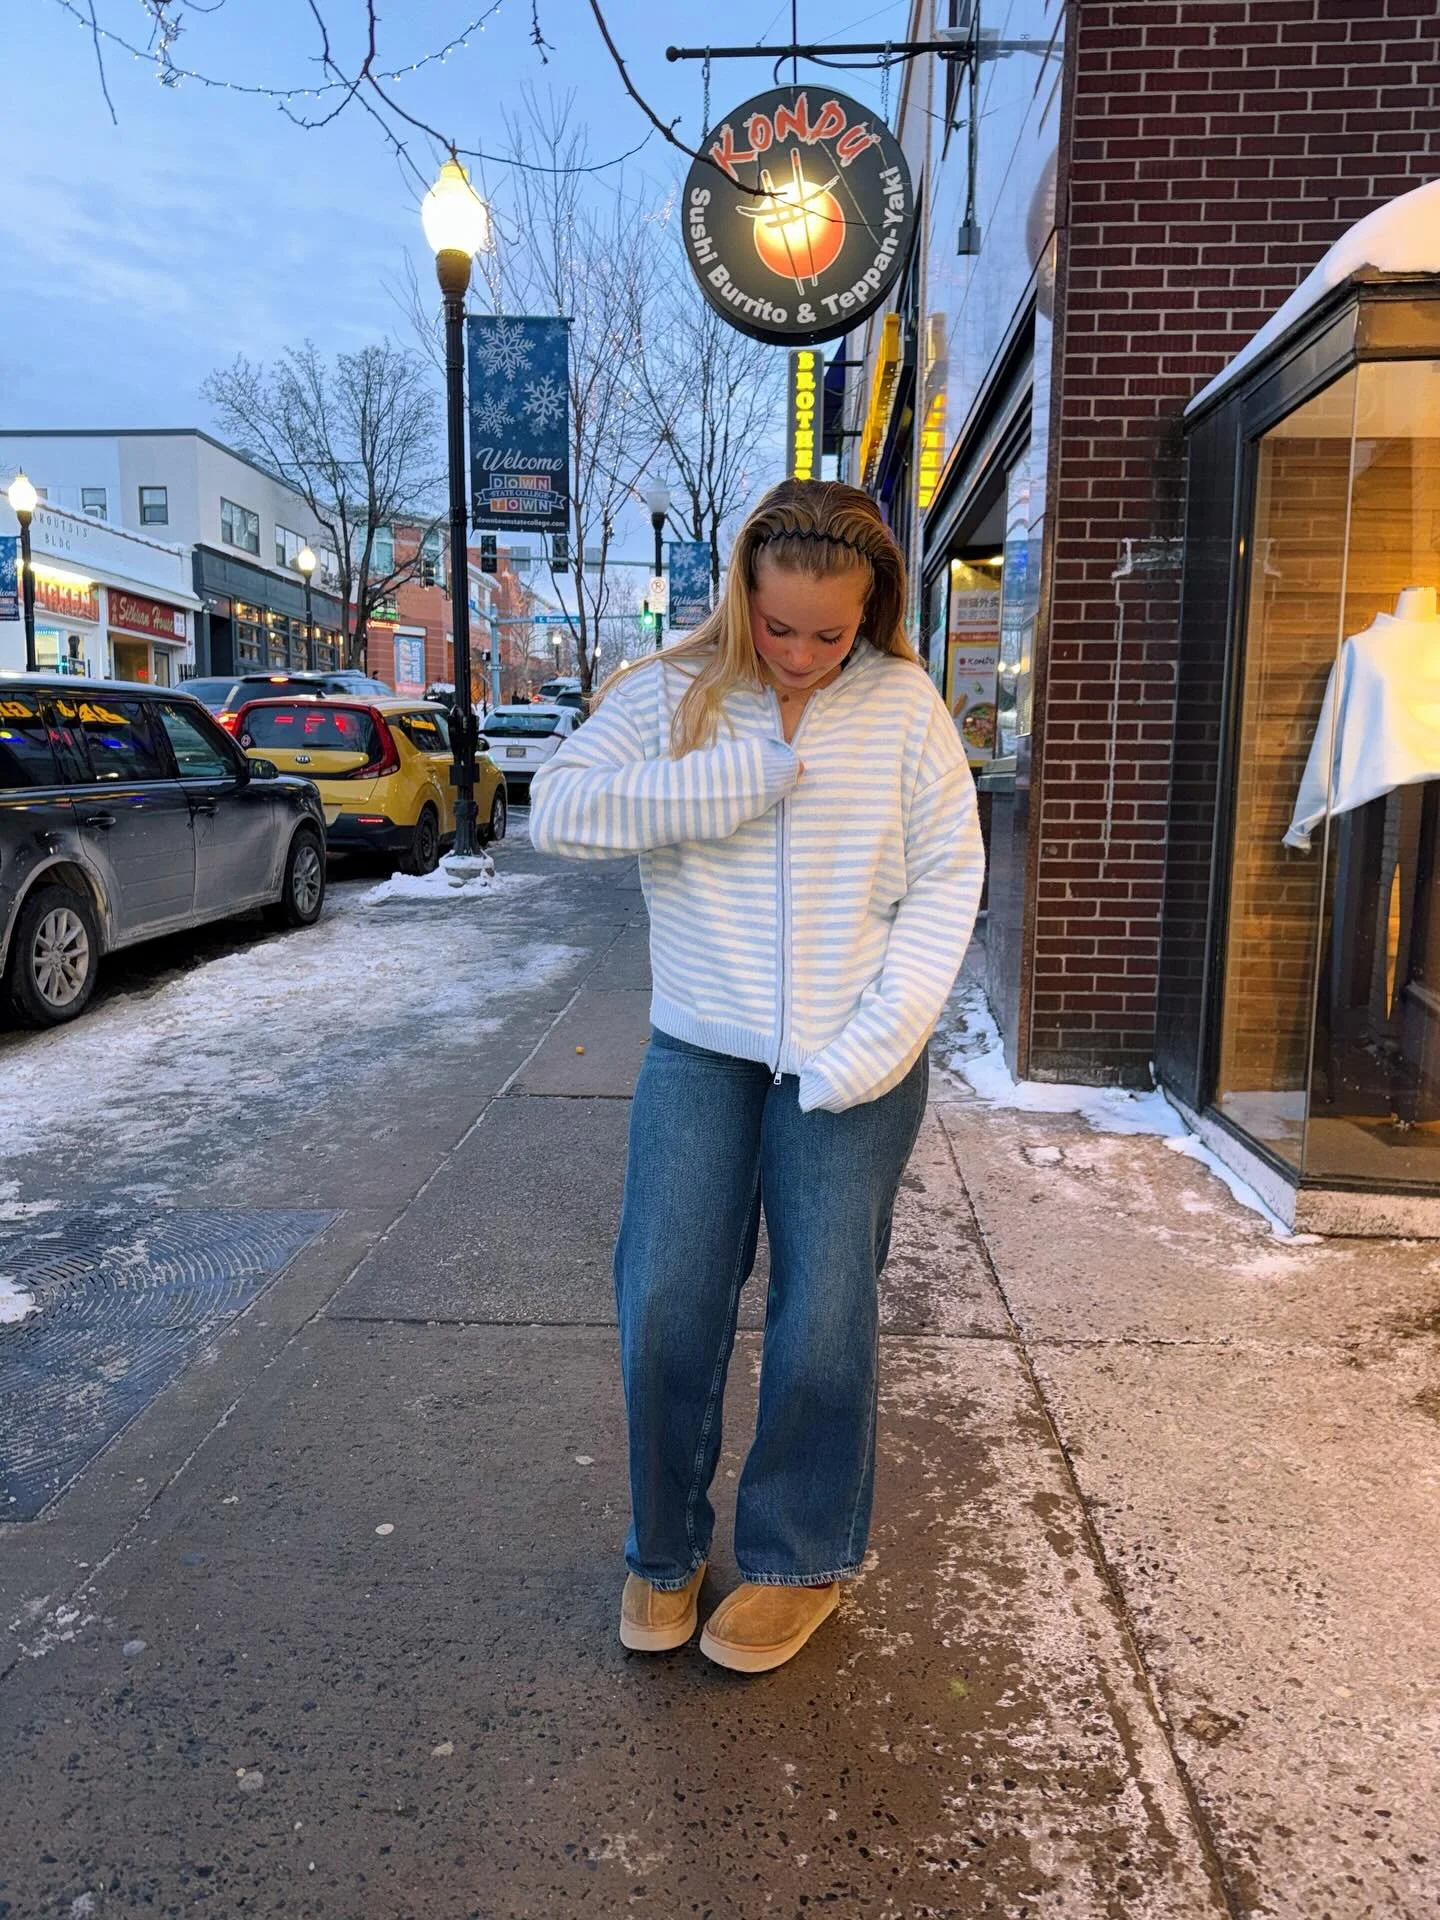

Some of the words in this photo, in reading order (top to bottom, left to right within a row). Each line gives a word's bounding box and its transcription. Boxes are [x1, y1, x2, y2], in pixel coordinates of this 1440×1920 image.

[709, 92, 880, 181] KONDU
[690, 187, 719, 265] Sushi
[707, 263, 788, 323] Burrito
[797, 303, 816, 324] &
[820, 166, 904, 317] Teppan-Yaki
[475, 447, 564, 472] Welcome
[493, 478, 549, 490] DOWN
[493, 499, 549, 511] TOWN
[476, 516, 566, 528] downtownstatecollege.com
